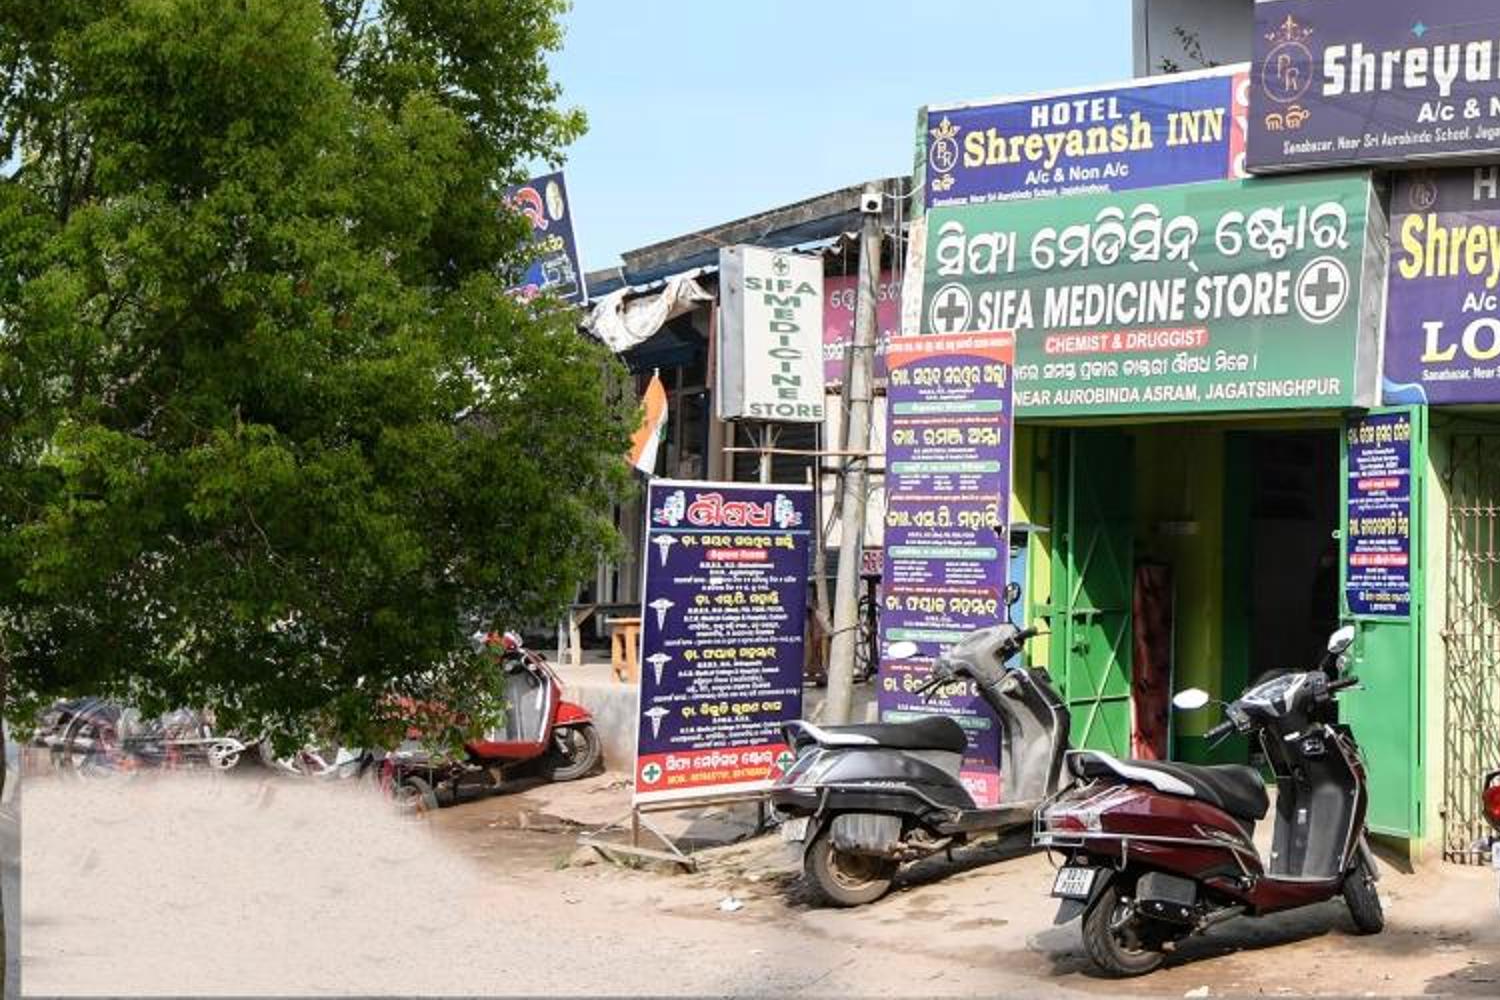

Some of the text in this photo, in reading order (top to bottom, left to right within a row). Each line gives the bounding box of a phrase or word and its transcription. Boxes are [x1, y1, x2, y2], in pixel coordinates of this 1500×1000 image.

[1031, 97, 1122, 128] HOTEL
[1417, 102, 1455, 123] A/c
[1464, 98, 1480, 119] &
[963, 111, 1153, 170] Shreyansh
[1166, 107, 1225, 146] INN
[1025, 163, 1129, 185] A/c & Non A/c
[936, 220, 1017, 277] ସିଫା
[744, 277, 817, 296] SIFA
[977, 270, 1291, 330] SIFA MEDICINE STORE
[1462, 291, 1498, 313] A/c
[764, 294, 802, 401] MEDICINE
[1045, 329, 1206, 353] CHEMIST & DRUGGIST
[1013, 378, 1340, 406] NEAR AUROBINDA ASRAM, JAGATSINGHPUR
[750, 403, 823, 417] STORE
